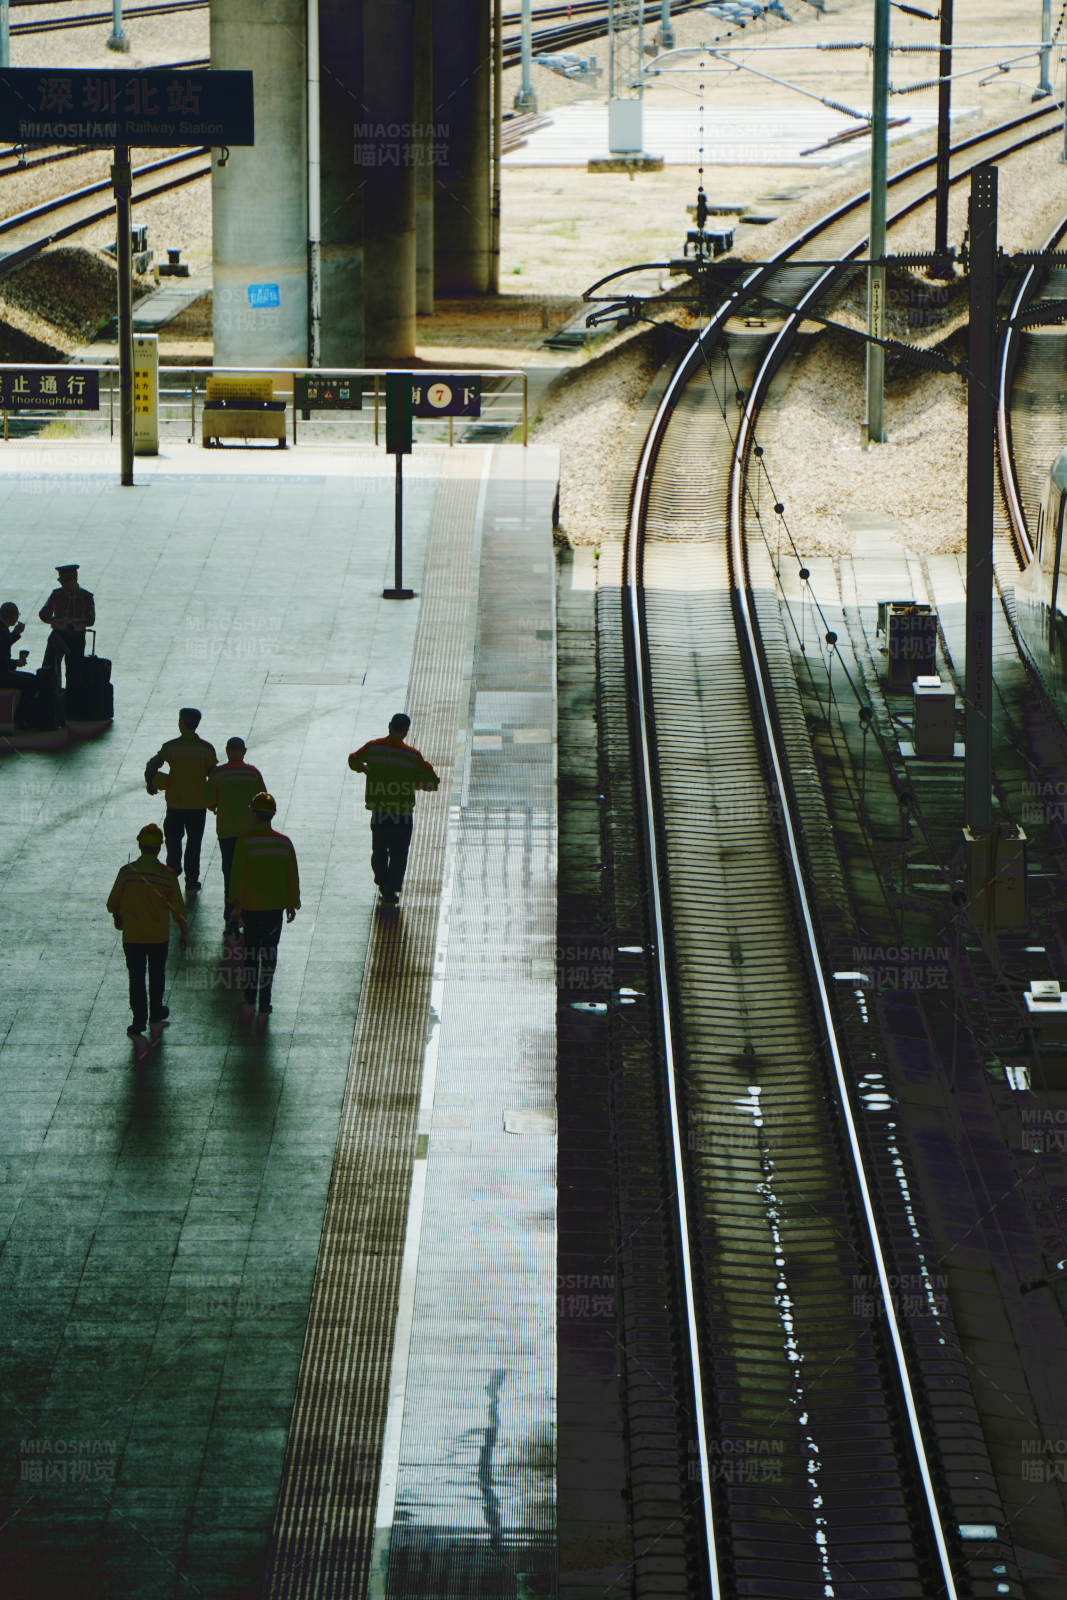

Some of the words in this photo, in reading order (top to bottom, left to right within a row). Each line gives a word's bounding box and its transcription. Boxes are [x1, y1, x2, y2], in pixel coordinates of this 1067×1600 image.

[39, 77, 201, 114] 深圳北站
[126, 120, 176, 136] Railway
[179, 120, 224, 134] Station
[0, 375, 86, 395] 止通行
[11, 395, 84, 407] Thoroughfare
[435, 389, 445, 402] 7
